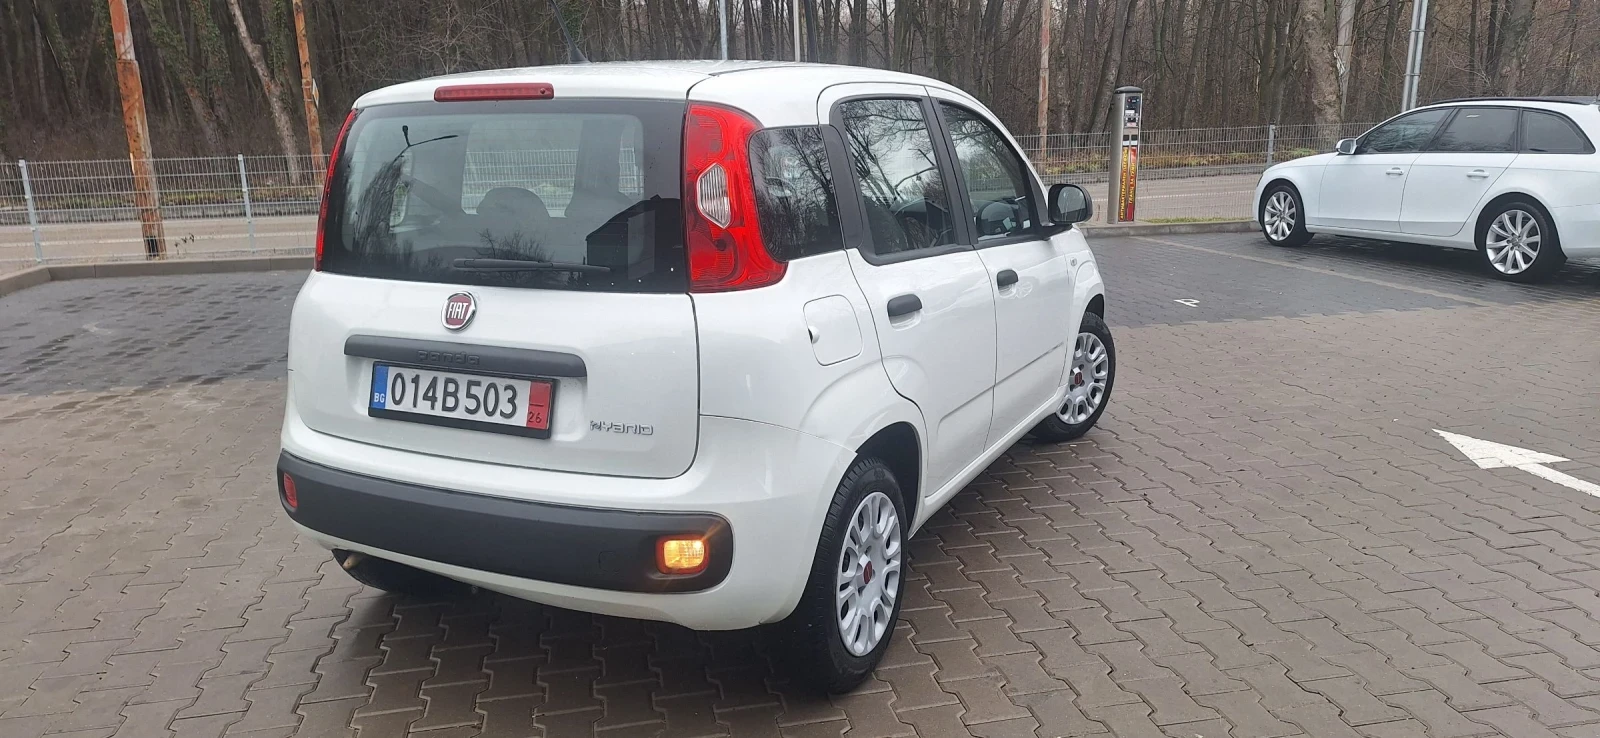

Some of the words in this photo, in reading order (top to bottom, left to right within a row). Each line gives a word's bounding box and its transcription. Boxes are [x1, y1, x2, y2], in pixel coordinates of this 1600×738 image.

[448, 302, 468, 320] FIAT
[416, 350, 481, 366] panda
[374, 392, 385, 404] BG
[390, 372, 518, 420] 014B503
[528, 411, 542, 424] 26
[590, 420, 654, 436] HYBRID
